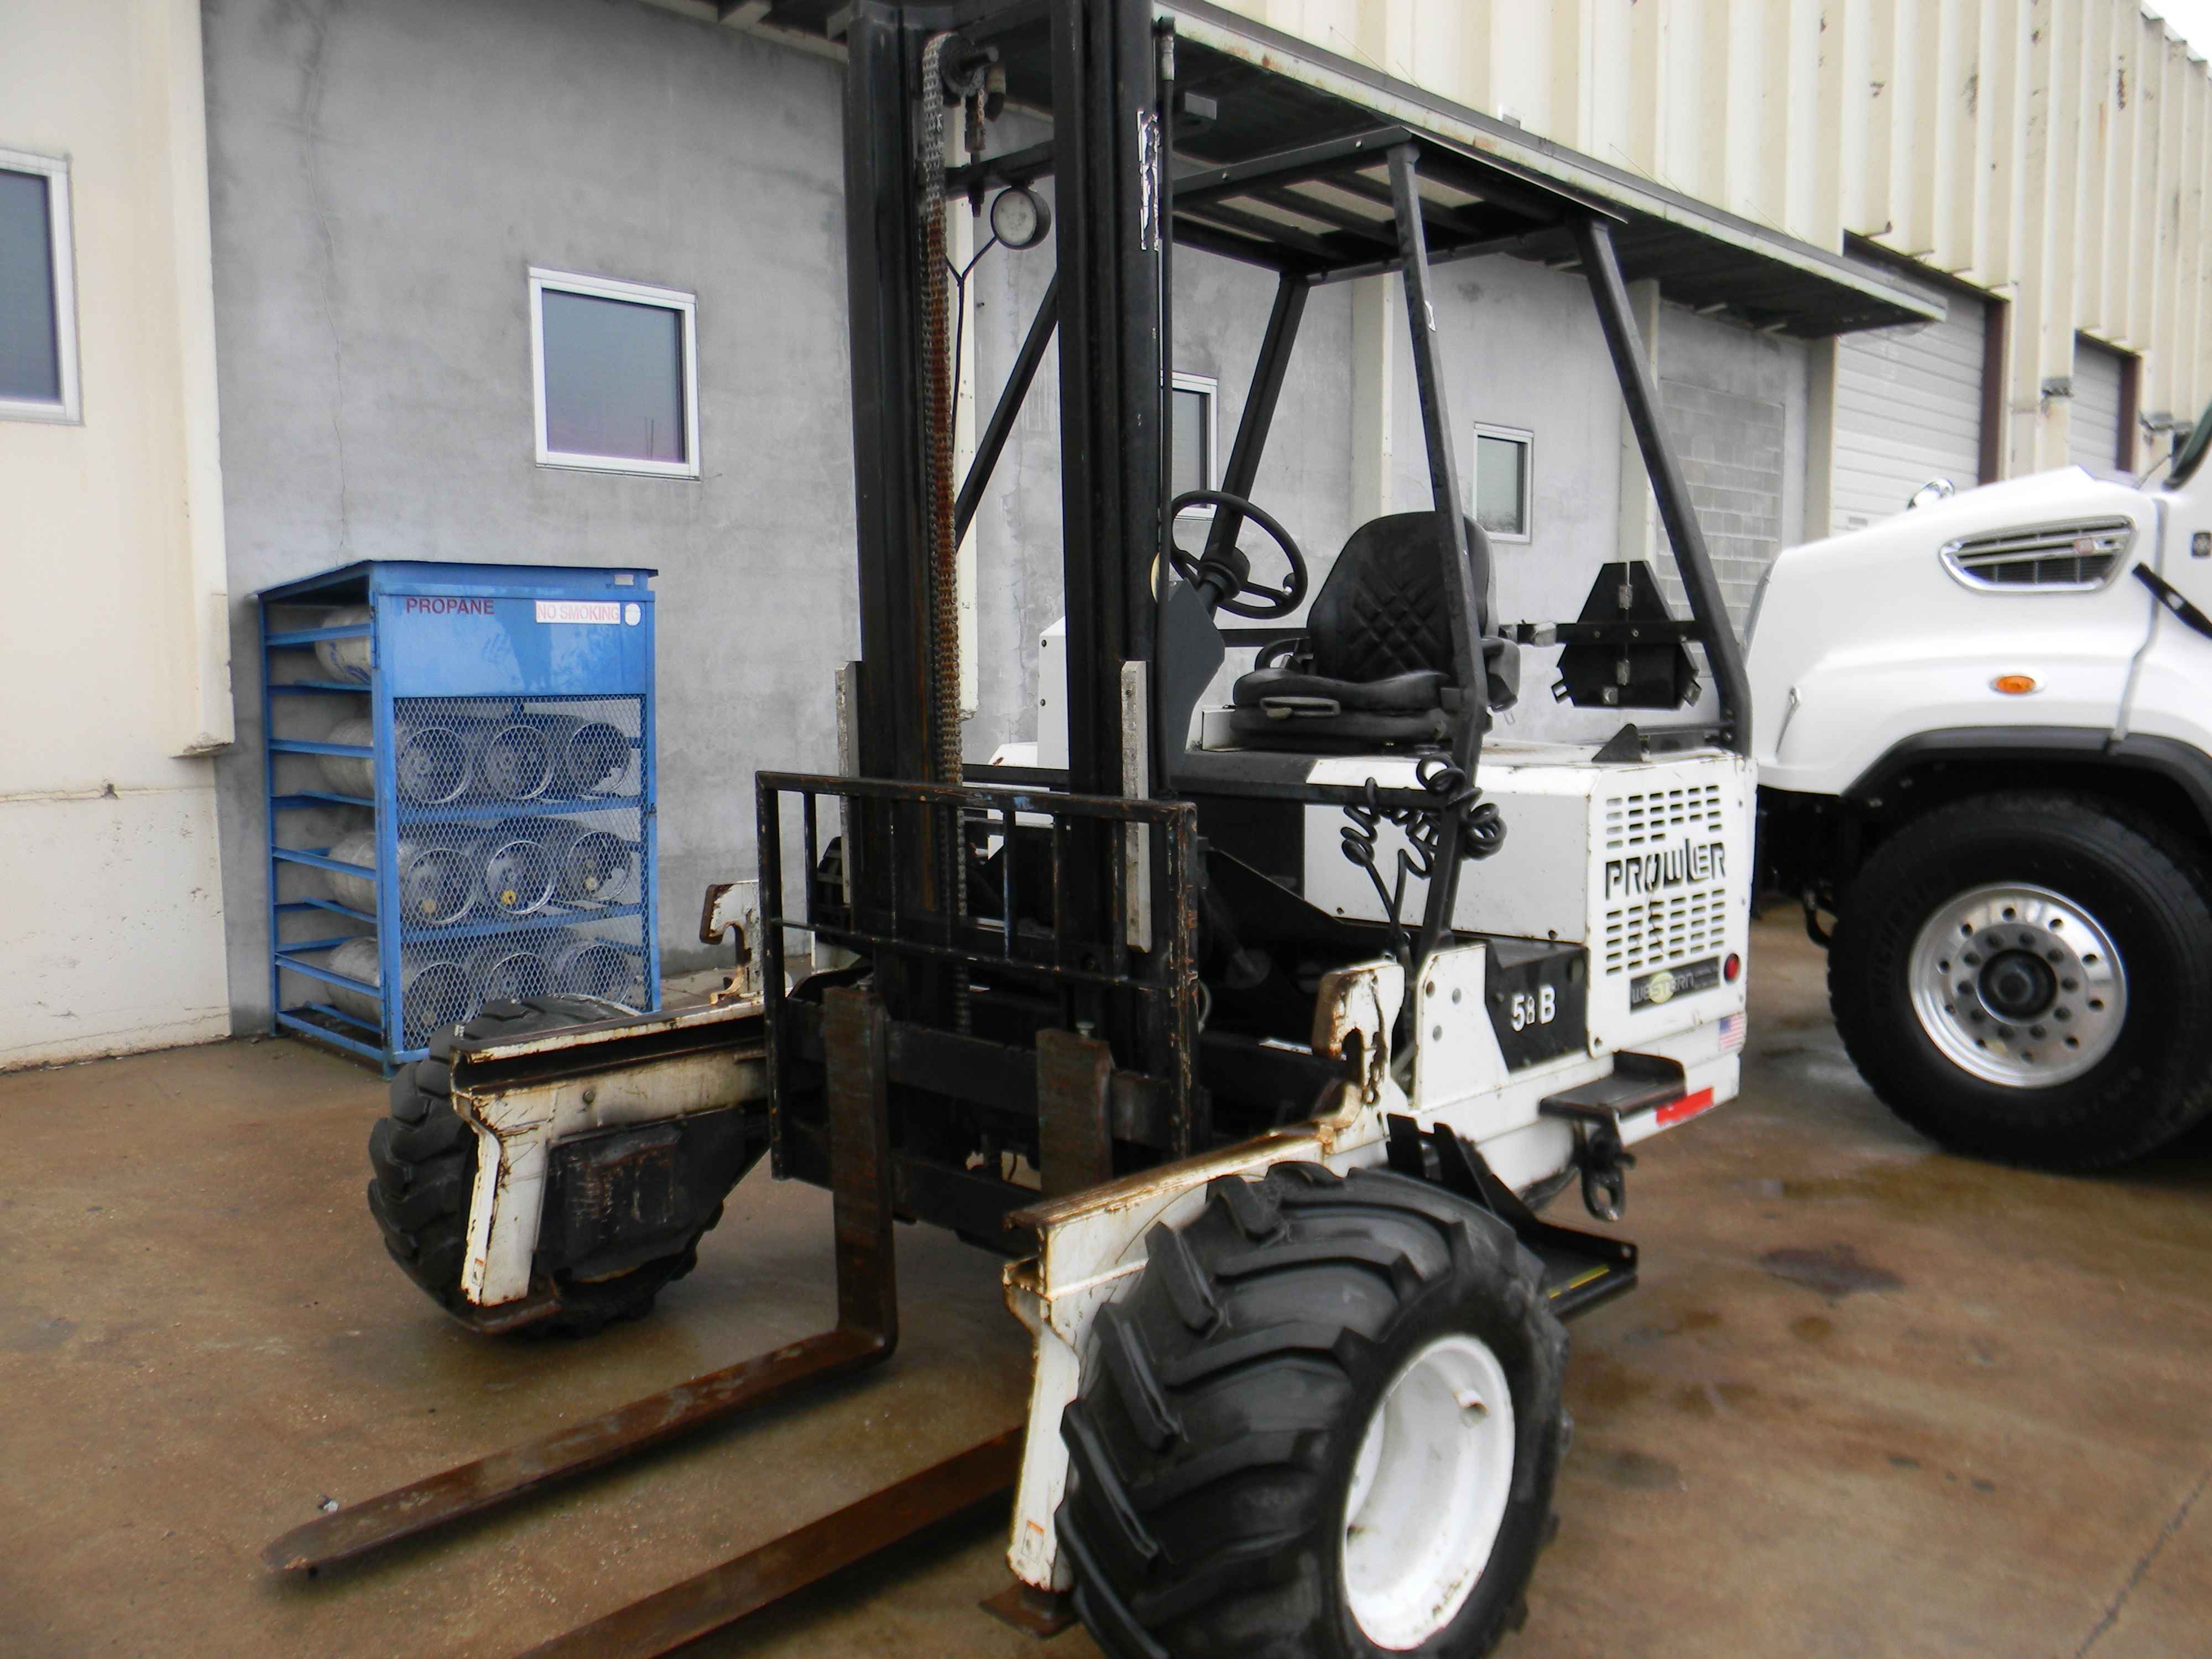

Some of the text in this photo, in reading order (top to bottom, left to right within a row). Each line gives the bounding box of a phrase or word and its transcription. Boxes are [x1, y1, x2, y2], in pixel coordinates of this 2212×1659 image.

[406, 598, 495, 615] PROPANE
[538, 604, 619, 620] NO SMOKING
[1605, 838, 1725, 900] PROWLER
